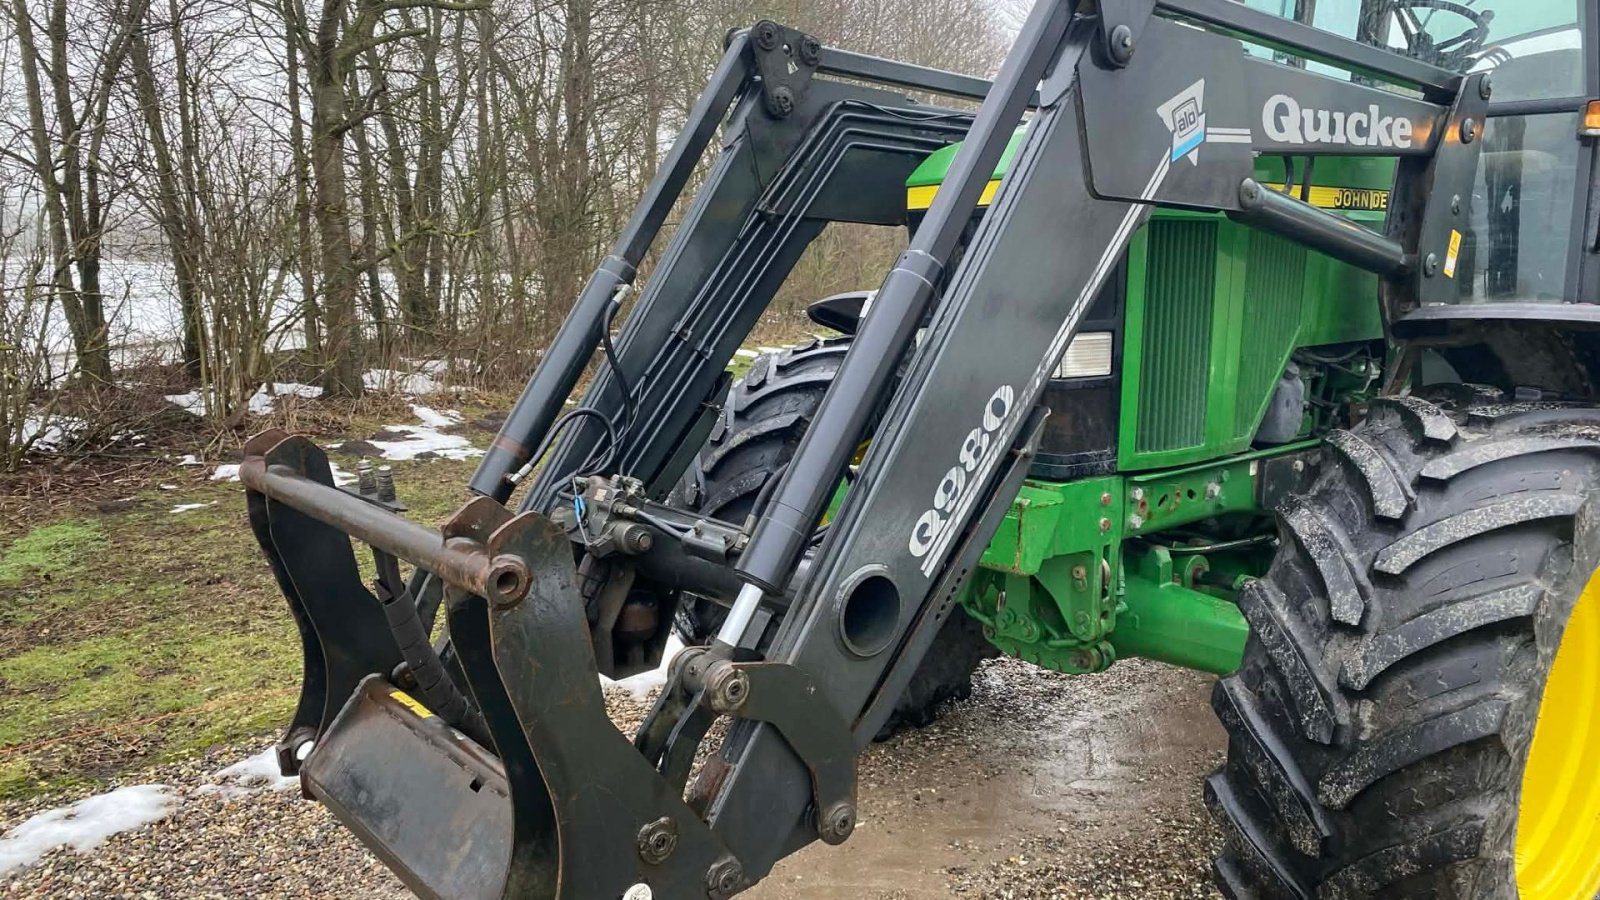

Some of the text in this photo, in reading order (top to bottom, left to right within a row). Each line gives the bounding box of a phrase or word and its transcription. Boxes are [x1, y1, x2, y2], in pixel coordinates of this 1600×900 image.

[1262, 94, 1413, 149] Quicke
[1334, 189, 1390, 209] JOHN DE
[909, 384, 1014, 557] Q980
